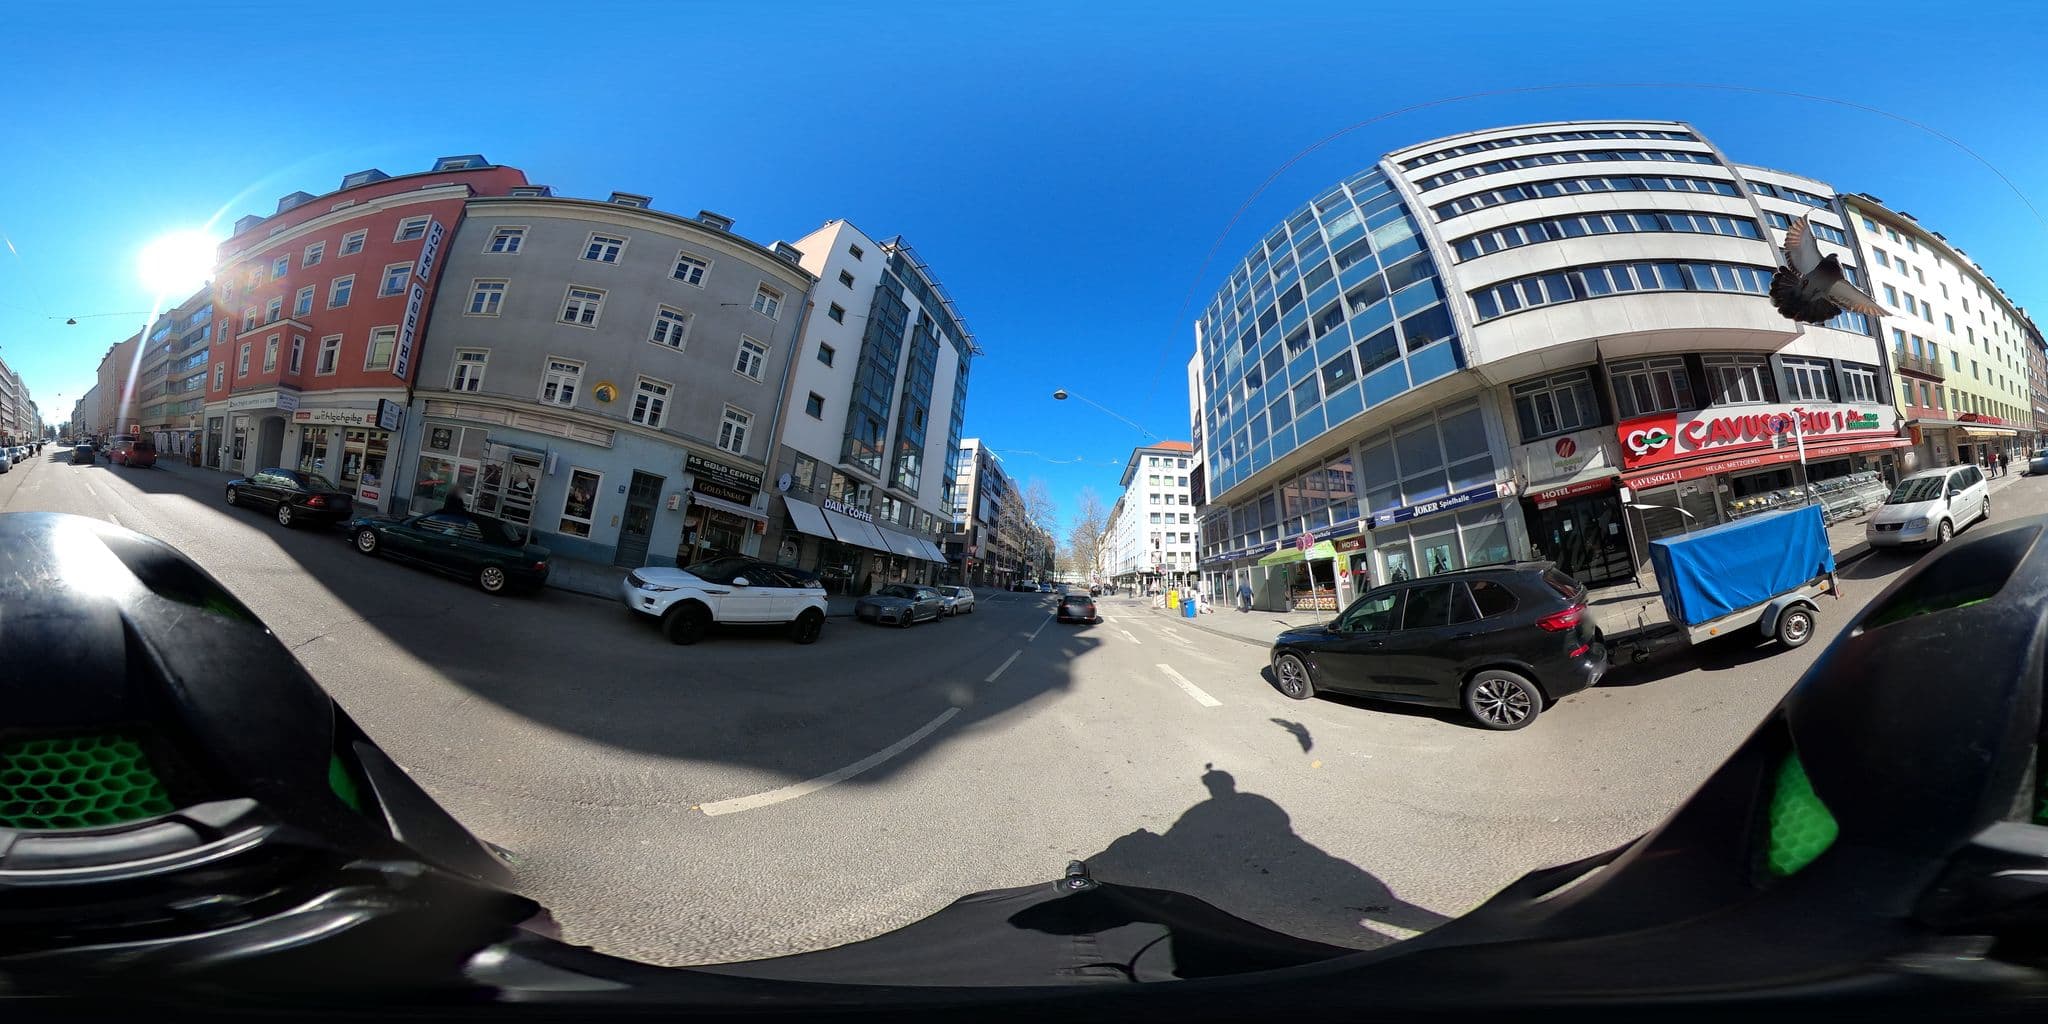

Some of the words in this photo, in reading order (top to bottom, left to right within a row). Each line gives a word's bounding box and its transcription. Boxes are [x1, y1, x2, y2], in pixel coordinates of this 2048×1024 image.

[420, 223, 443, 279] HOTEL
[398, 288, 423, 375] GOETHE
[689, 456, 702, 465] AS
[704, 460, 728, 473] GOLD
[729, 470, 760, 484] CENTER
[1541, 487, 1571, 499] HOTEL
[825, 499, 848, 515] DAILY
[848, 507, 873, 522] COFFEE
[1413, 502, 1439, 517] JOKER
[1439, 494, 1470, 508] Spielhalle
[1341, 540, 1360, 549] HOTEL
